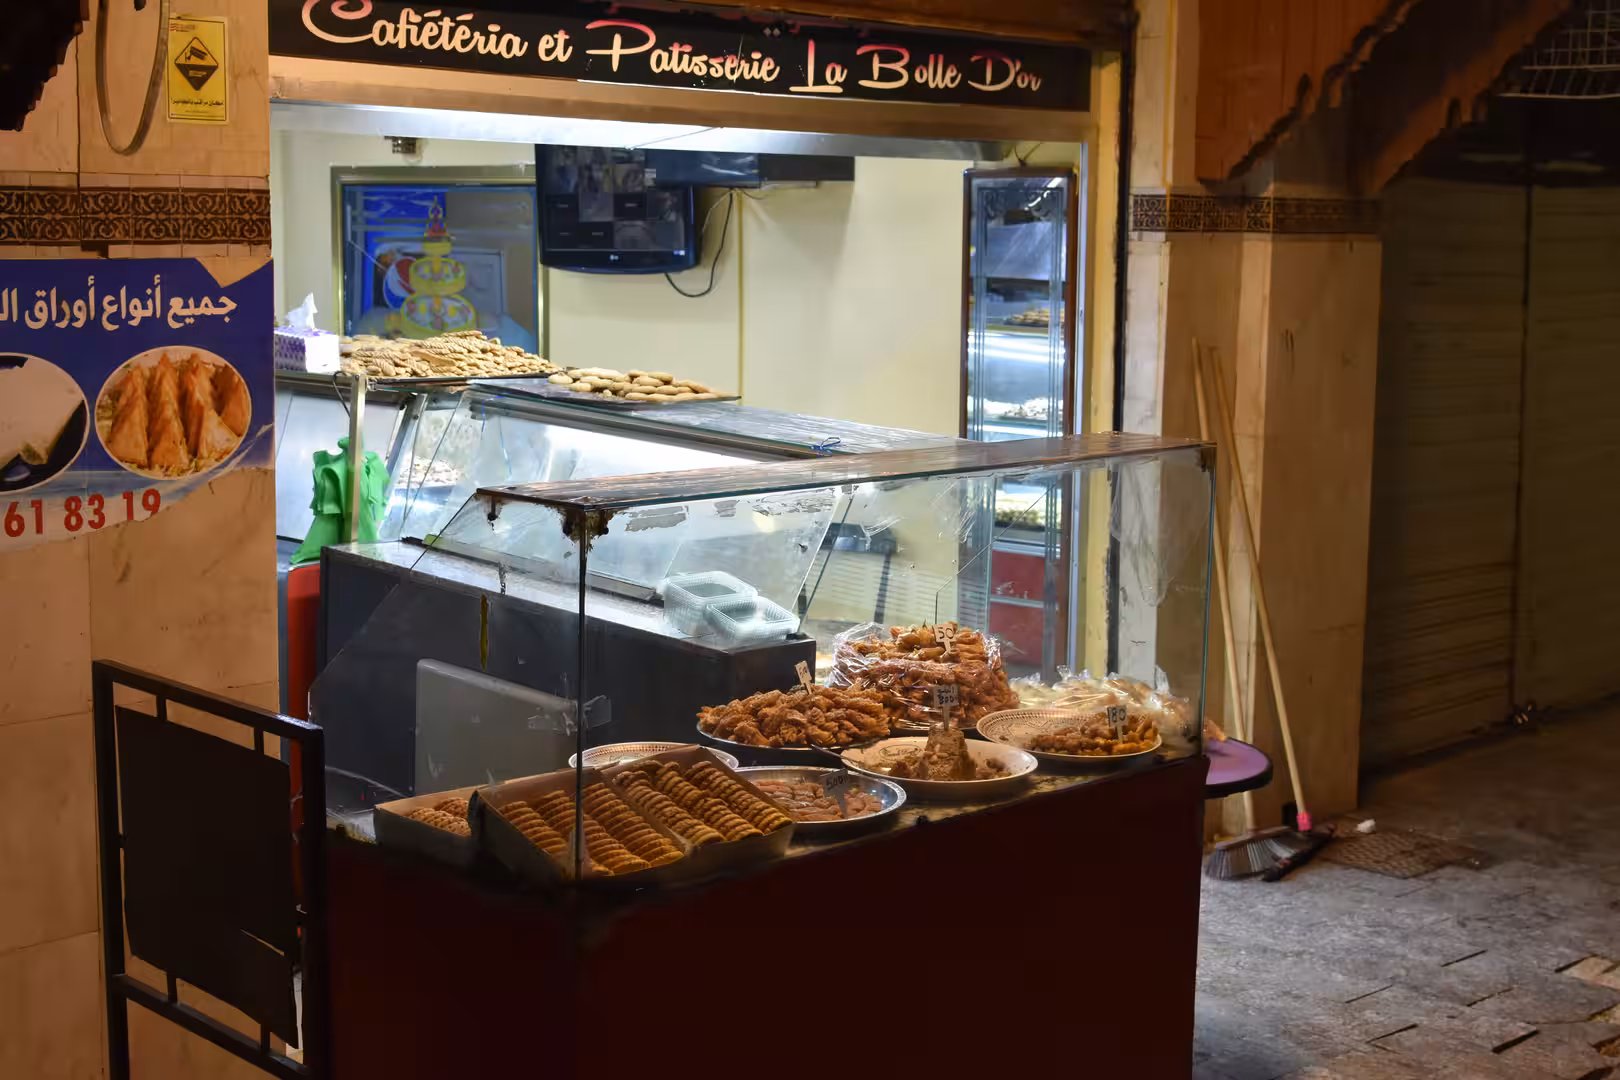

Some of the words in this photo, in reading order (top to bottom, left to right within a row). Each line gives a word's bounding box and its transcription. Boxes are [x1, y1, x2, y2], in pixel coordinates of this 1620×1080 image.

[537, 30, 573, 62] et
[585, 19, 780, 81] Patisserie
[788, 39, 848, 93] La
[967, 53, 1042, 91] D'or
[24, 275, 95, 330] أوراق
[101, 274, 161, 331] أنواع
[167, 295, 238, 329] جميع
[4, 499, 43, 537] 61
[64, 493, 105, 532] 83
[122, 488, 161, 520] 19
